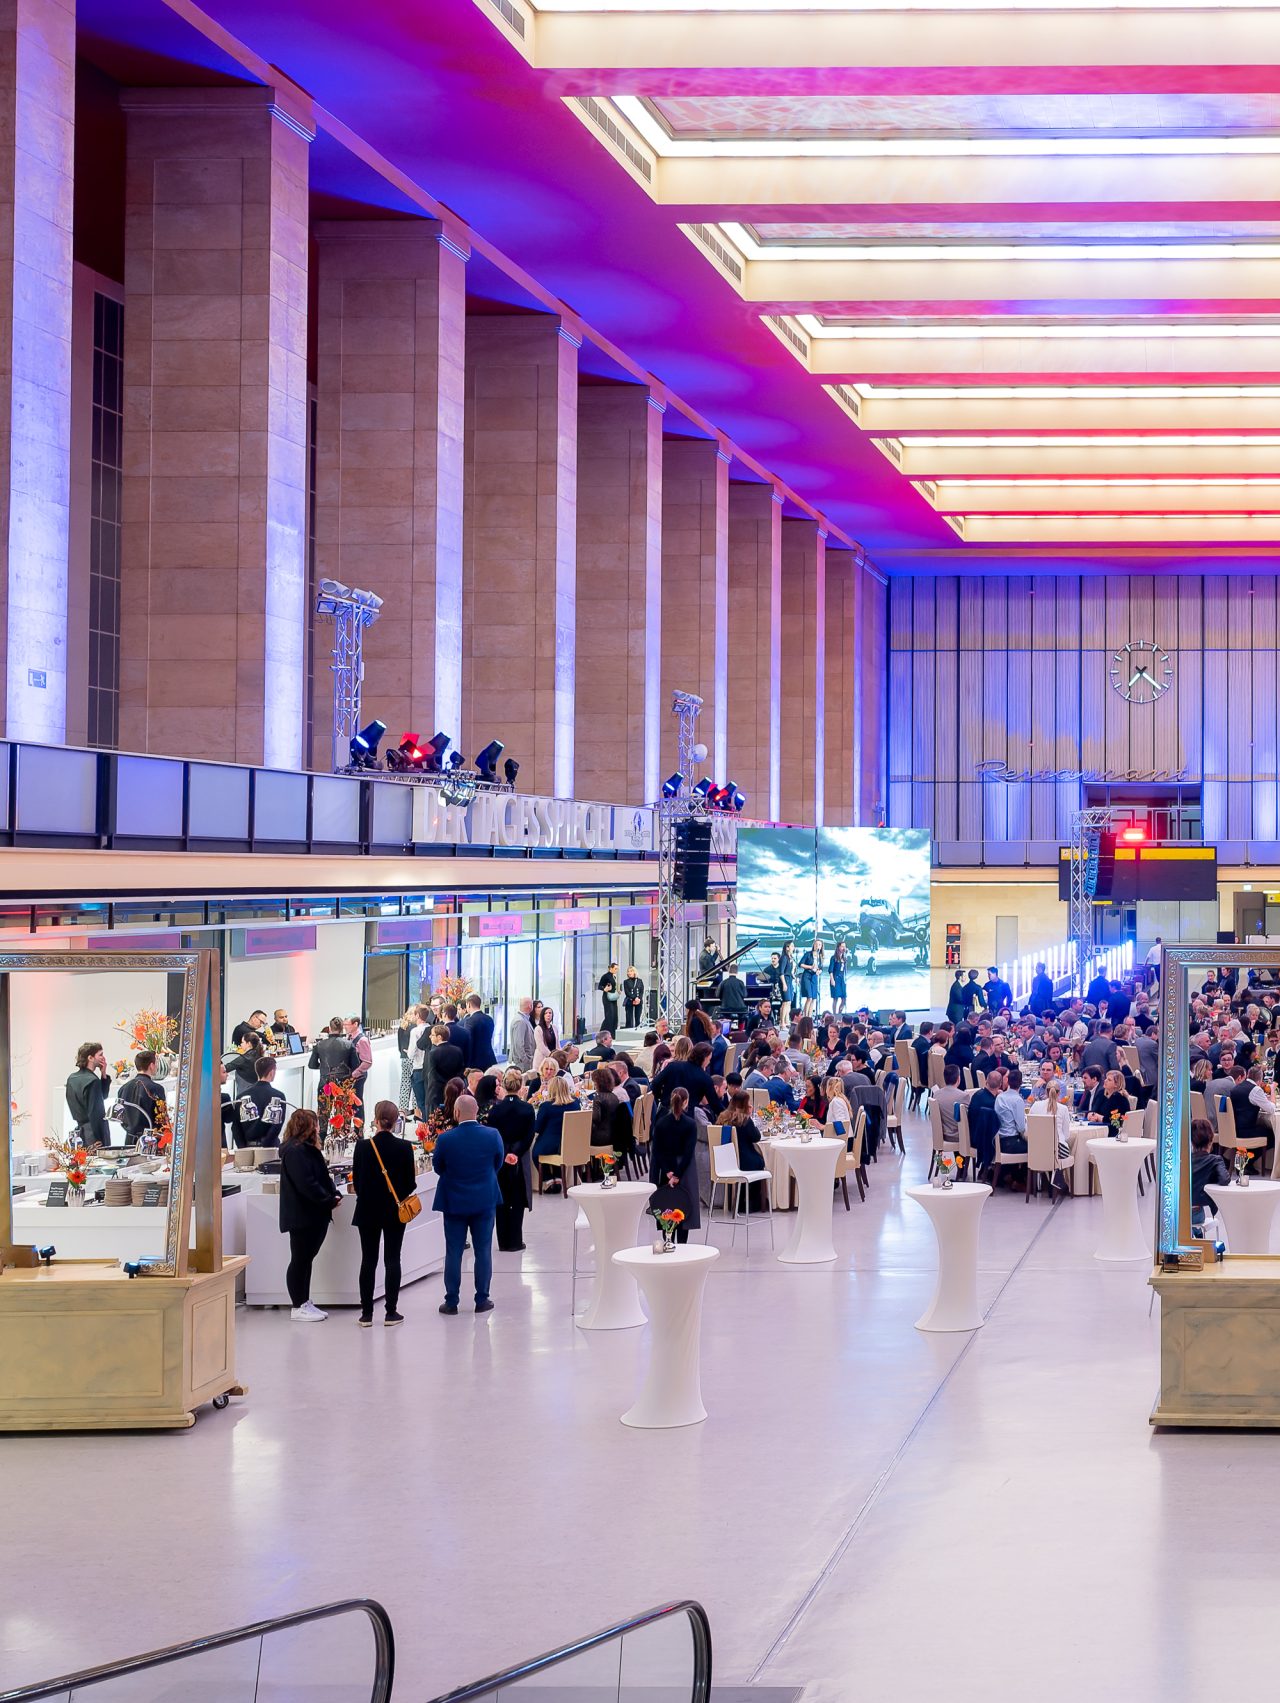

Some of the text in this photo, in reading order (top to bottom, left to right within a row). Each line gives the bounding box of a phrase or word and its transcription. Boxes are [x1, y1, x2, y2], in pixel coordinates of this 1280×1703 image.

[975, 760, 1189, 785] Restaurant
[423, 787, 615, 848] DER TAGESSPIEGEL
